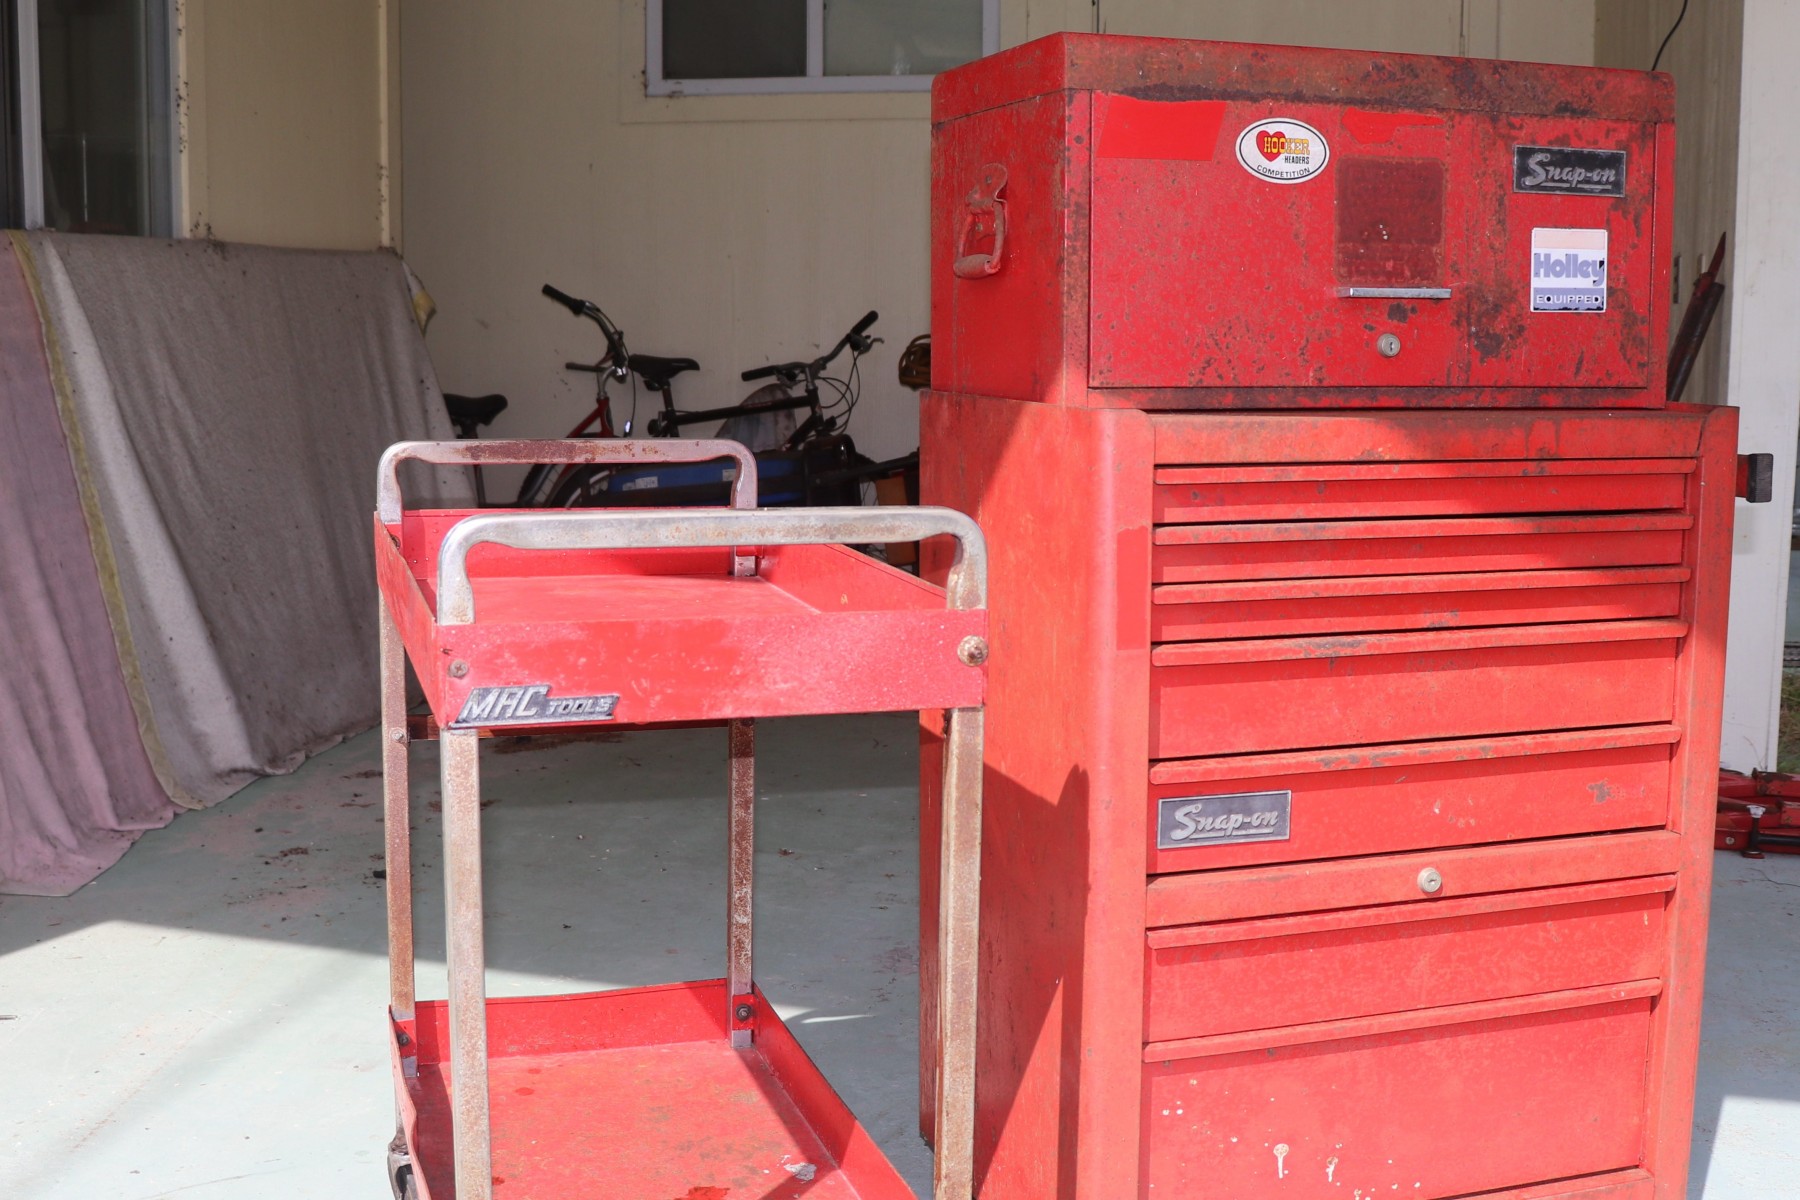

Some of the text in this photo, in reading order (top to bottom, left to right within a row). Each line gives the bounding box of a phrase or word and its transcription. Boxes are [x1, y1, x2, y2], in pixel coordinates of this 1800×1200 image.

[1263, 136, 1310, 156] HOOKER
[1256, 164, 1311, 178] COMPETITION
[1284, 155, 1310, 165] HEADERS
[1521, 152, 1616, 188] Snap-on
[1533, 253, 1605, 287] Holley
[1536, 294, 1601, 305] EQUIPPED
[461, 686, 614, 720] MAC TOOLS
[1170, 803, 1279, 841] Snap-on
